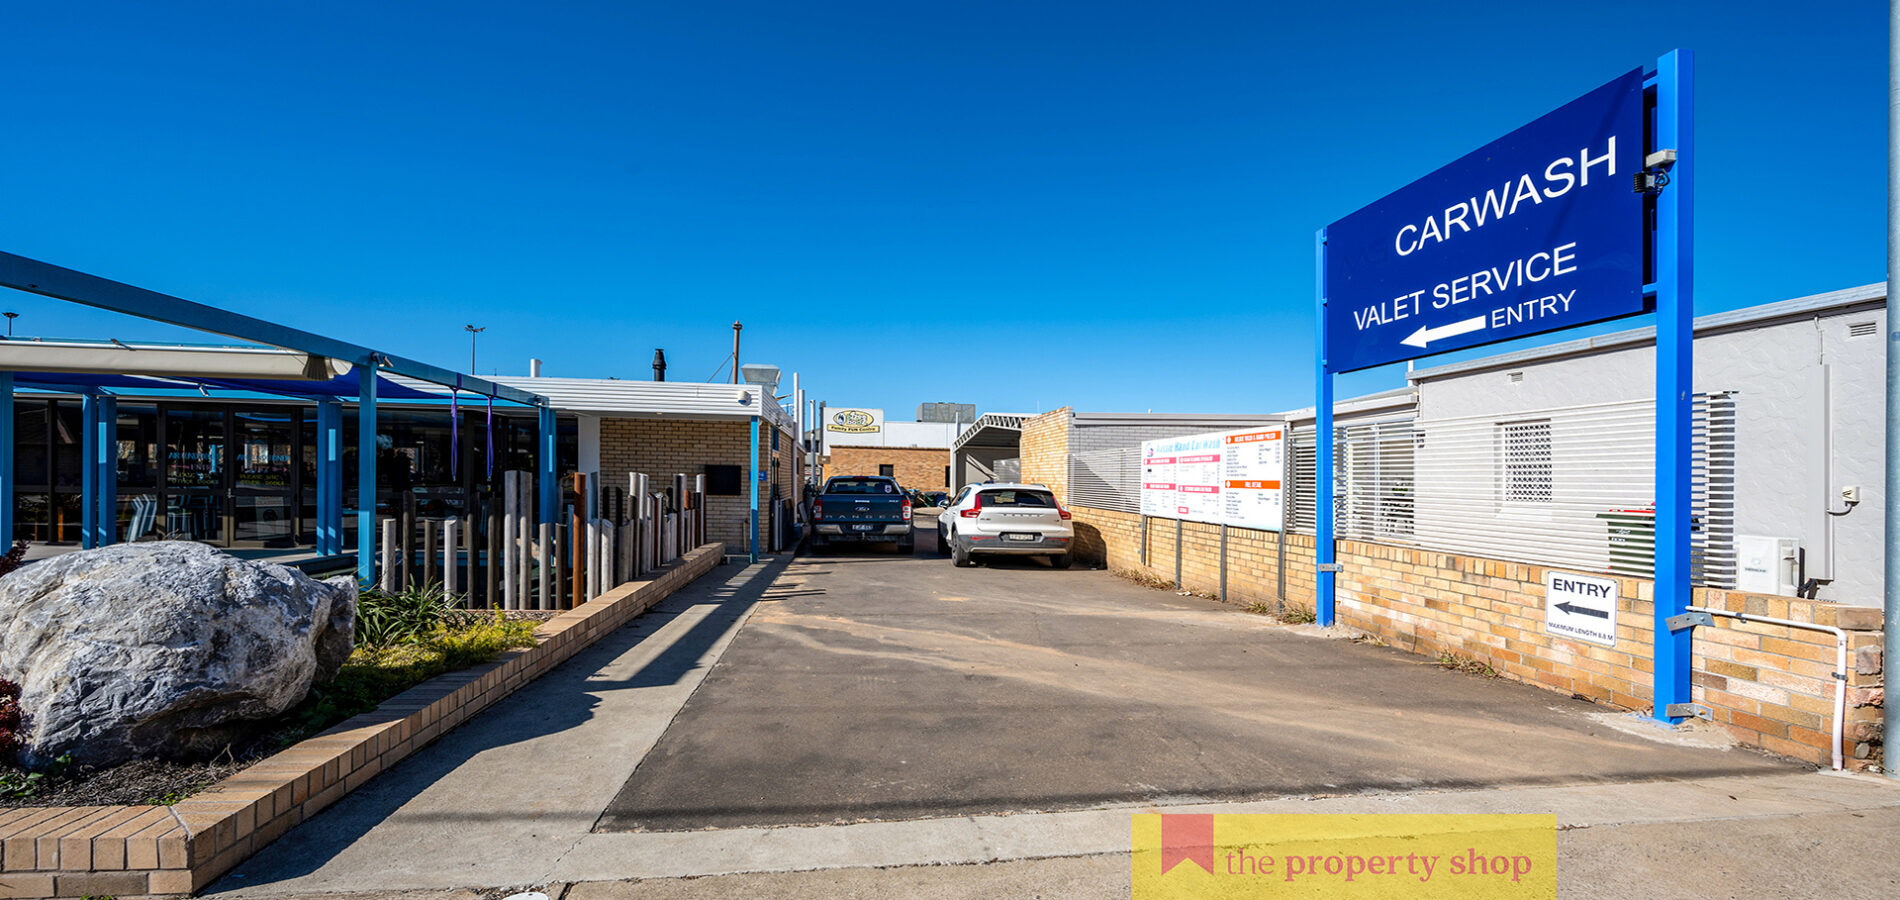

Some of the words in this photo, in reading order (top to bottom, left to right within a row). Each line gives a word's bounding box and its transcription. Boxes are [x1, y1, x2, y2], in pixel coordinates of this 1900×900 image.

[1395, 135, 1616, 256] CARWASH
[1353, 289, 1426, 331] VALET
[1432, 241, 1577, 309] SERVICE
[1491, 289, 1577, 329] ENTRY
[1553, 578, 1611, 598] ENTRY
[1548, 622, 1574, 632] MAXIMUM
[1575, 627, 1597, 636] LENGTH
